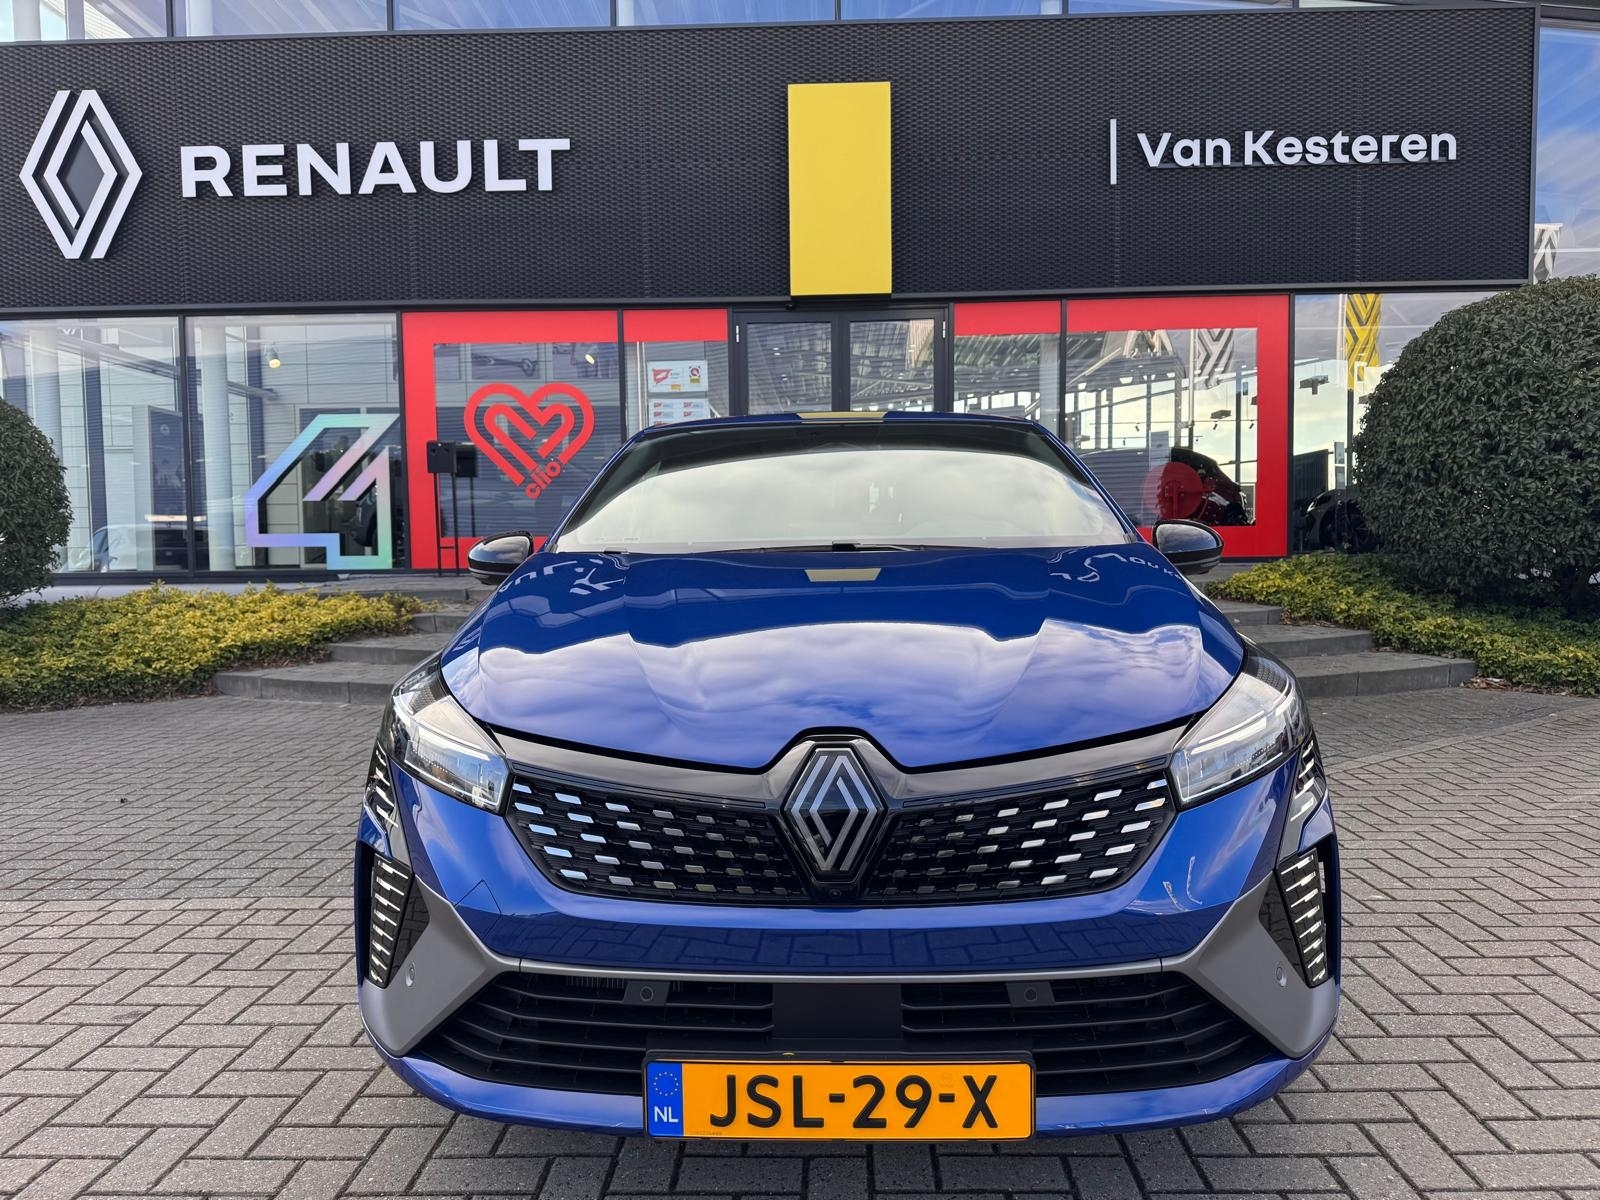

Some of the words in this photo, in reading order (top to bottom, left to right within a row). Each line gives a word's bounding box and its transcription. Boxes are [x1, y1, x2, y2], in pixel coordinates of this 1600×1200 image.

[180, 138, 571, 198] RENAULT
[1137, 132, 1231, 168] Van
[1244, 130, 1458, 165] Kesteren
[525, 461, 561, 499] clio
[653, 1105, 680, 1124] NL
[709, 1074, 998, 1129] JSL-29-X
